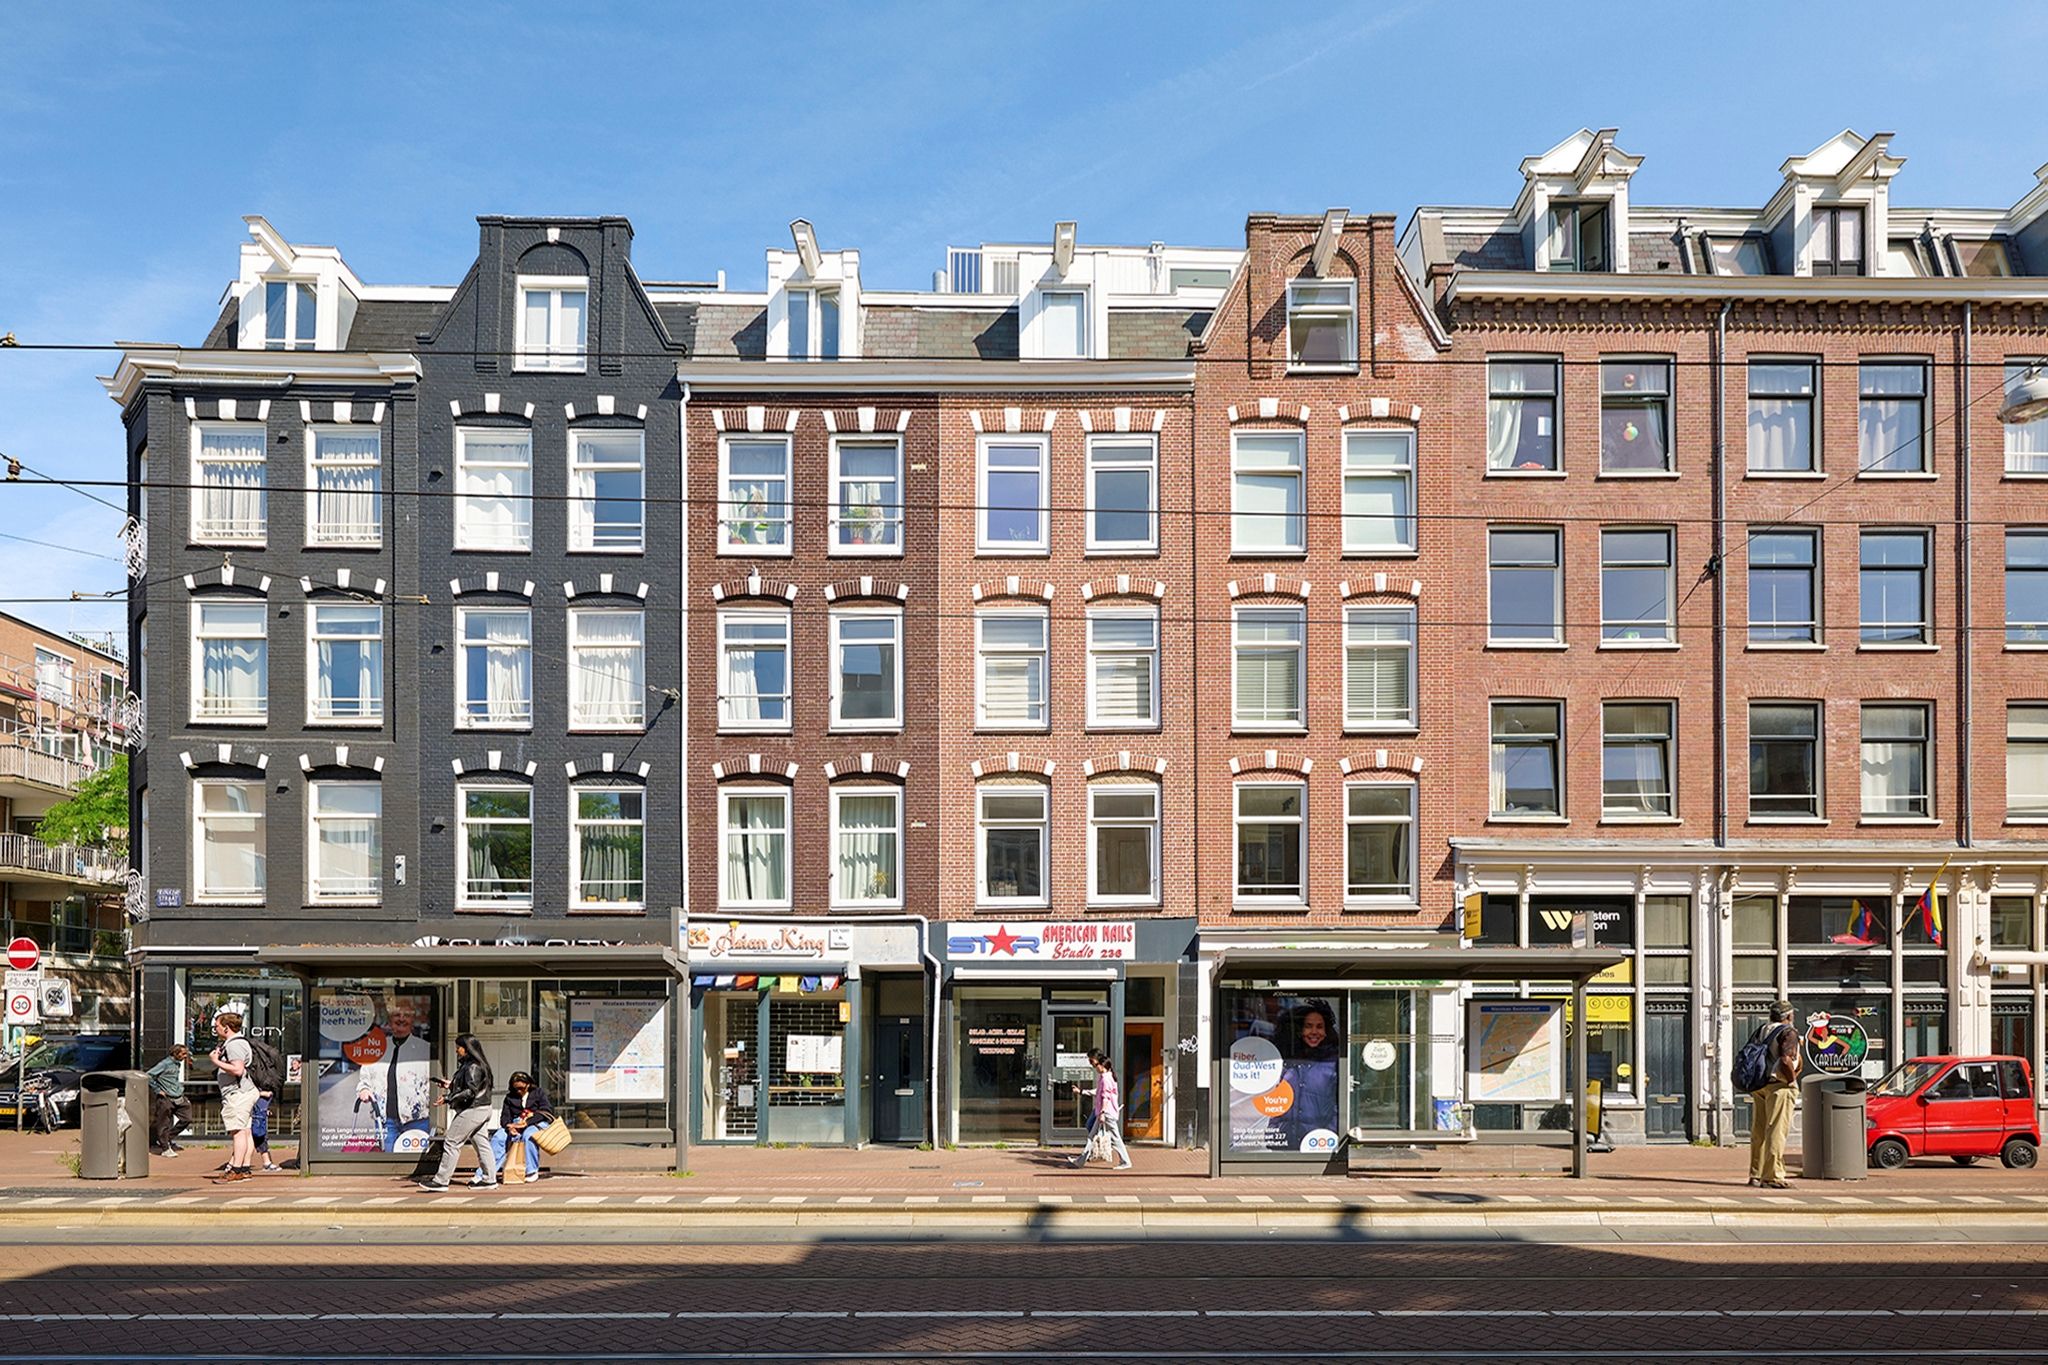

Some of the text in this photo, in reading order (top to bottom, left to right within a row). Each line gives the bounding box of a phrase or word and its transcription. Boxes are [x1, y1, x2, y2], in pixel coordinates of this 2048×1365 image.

[1042, 925, 1098, 944] AMERICAN
[1102, 925, 1133, 943] NAILS
[710, 927, 768, 957] Asian
[771, 927, 825, 958] King
[1052, 943, 1093, 959] Studio
[15, 1001, 28, 1010] 30
[348, 1017, 366, 1025] het!
[251, 1026, 285, 1037] CITY
[368, 1038, 381, 1046] Nu
[353, 1046, 383, 1057] jij nog.
[1233, 1052, 1257, 1061] Fiber.
[1233, 1061, 1276, 1070] Oud-West
[1233, 1071, 1260, 1079] has it!
[1264, 1096, 1288, 1104] You're
[1265, 1105, 1285, 1113] next.
